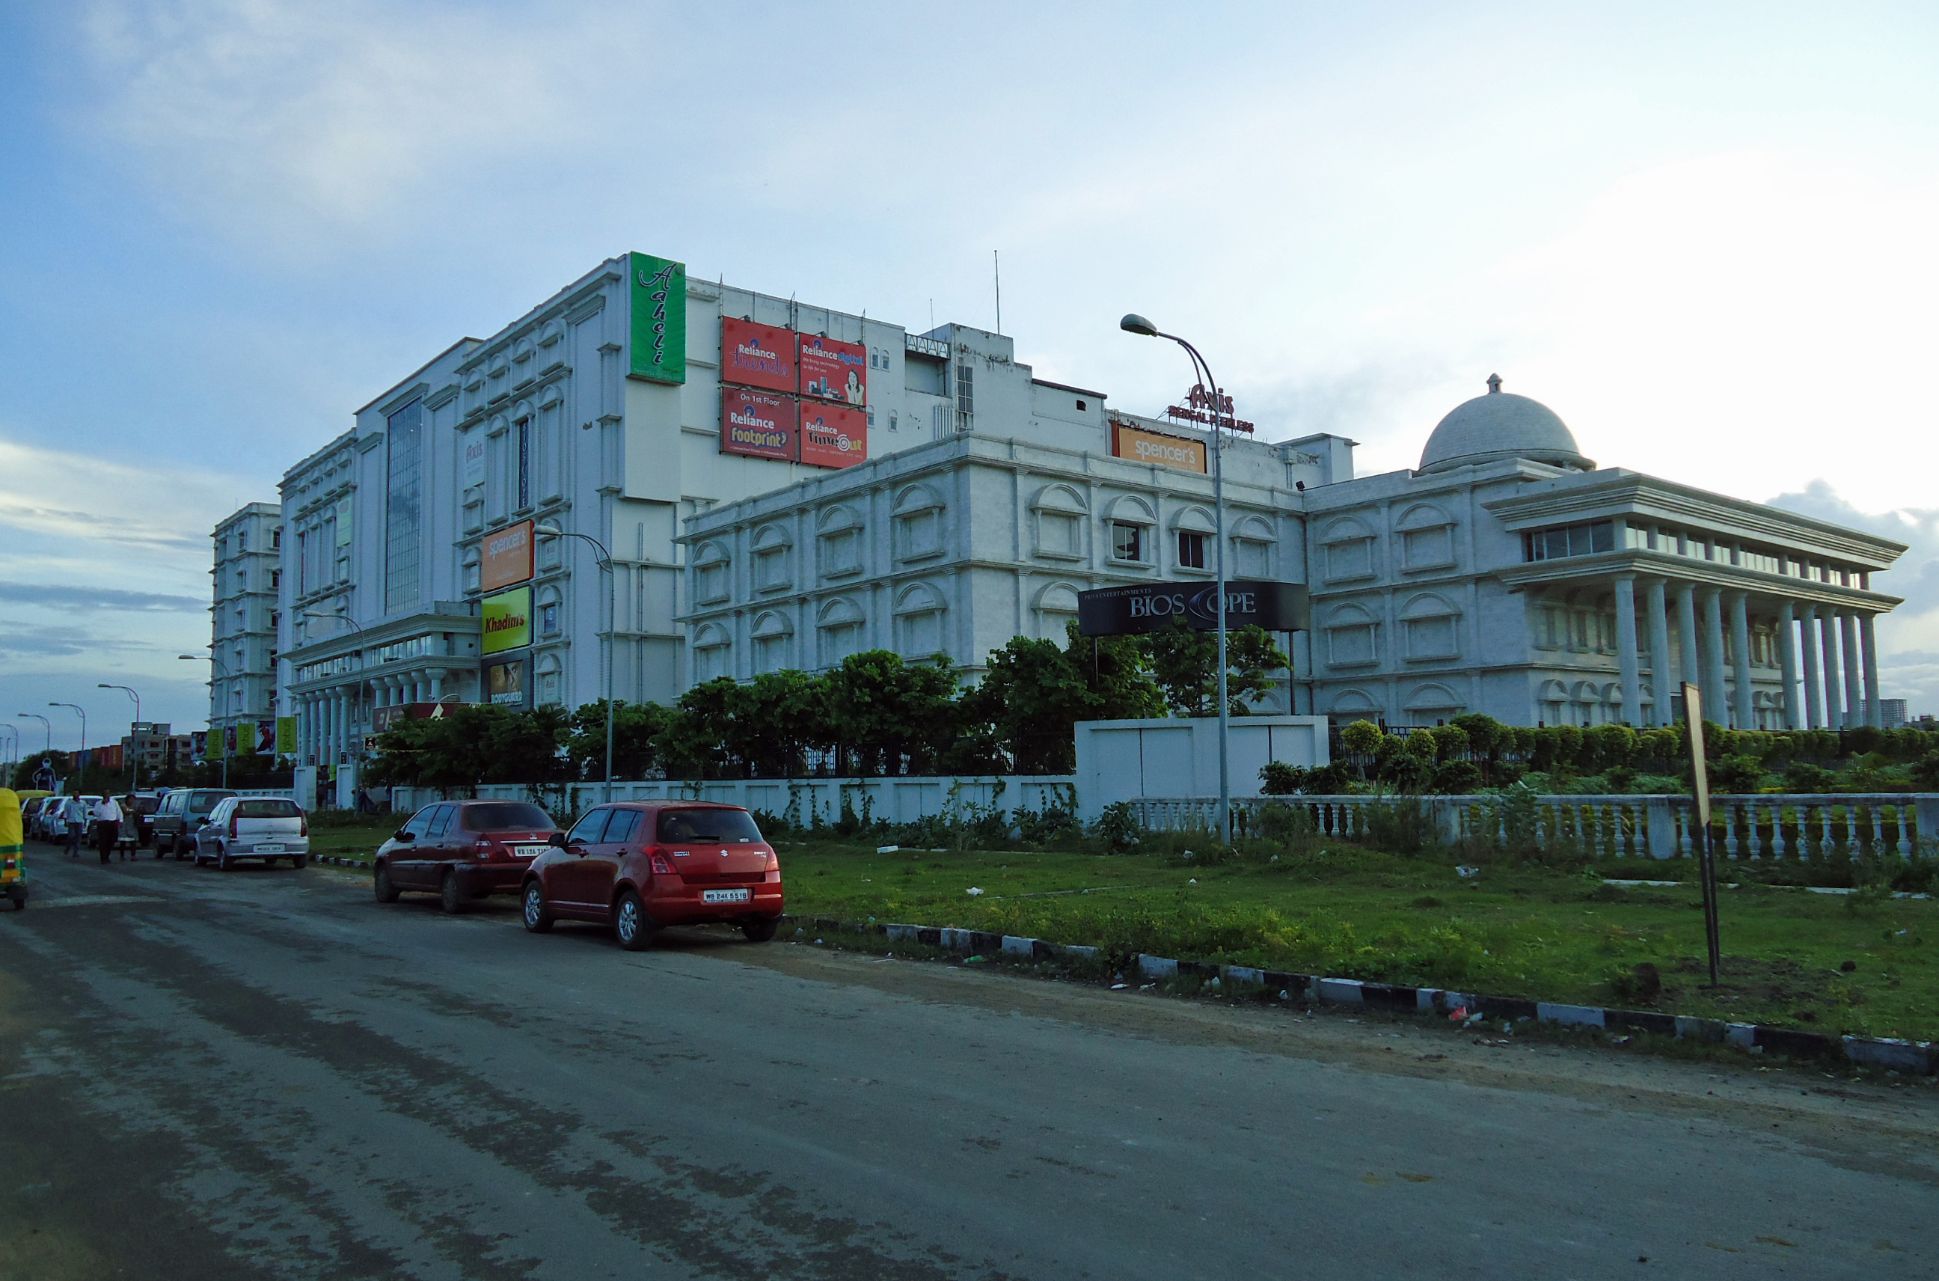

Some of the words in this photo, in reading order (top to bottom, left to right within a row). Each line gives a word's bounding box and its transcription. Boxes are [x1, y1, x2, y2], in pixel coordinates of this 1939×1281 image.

[738, 343, 777, 360] Reliance
[802, 344, 838, 360] Reliance
[763, 397, 781, 406] Floor
[730, 411, 775, 430] Reliance
[806, 421, 838, 435] Reliance
[1135, 440, 1197, 465] spencer's
[485, 612, 525, 634] Khadim's
